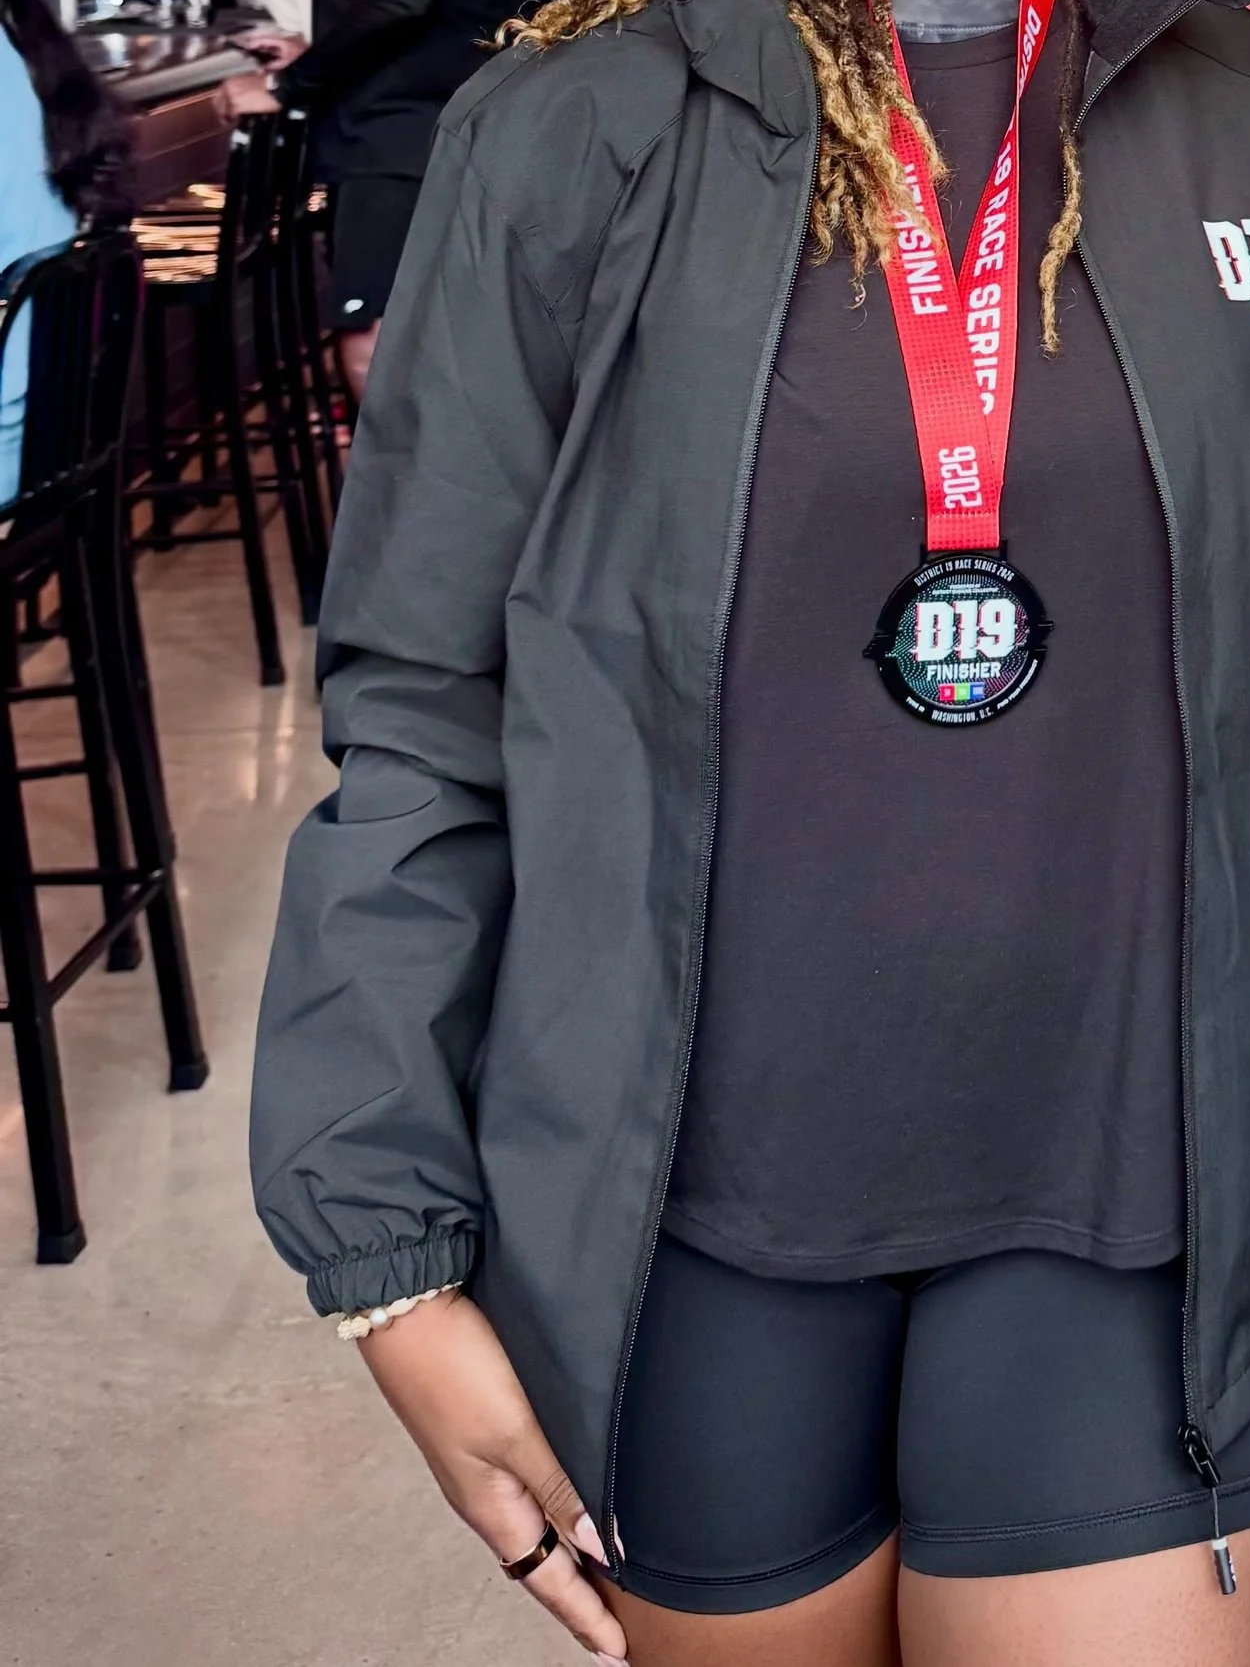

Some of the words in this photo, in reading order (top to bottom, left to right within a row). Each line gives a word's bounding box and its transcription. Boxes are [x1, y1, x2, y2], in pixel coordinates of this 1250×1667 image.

[994, 141, 1012, 187] 19
[973, 192, 1009, 278] RACE
[937, 444, 983, 511] 2026
[913, 564, 944, 587] DISTRICT
[954, 559, 973, 570] RACE
[973, 559, 998, 574] SERIES
[996, 565, 1015, 583] 2026
[912, 598, 1018, 663] D19
[926, 661, 1003, 681] FINISHER
